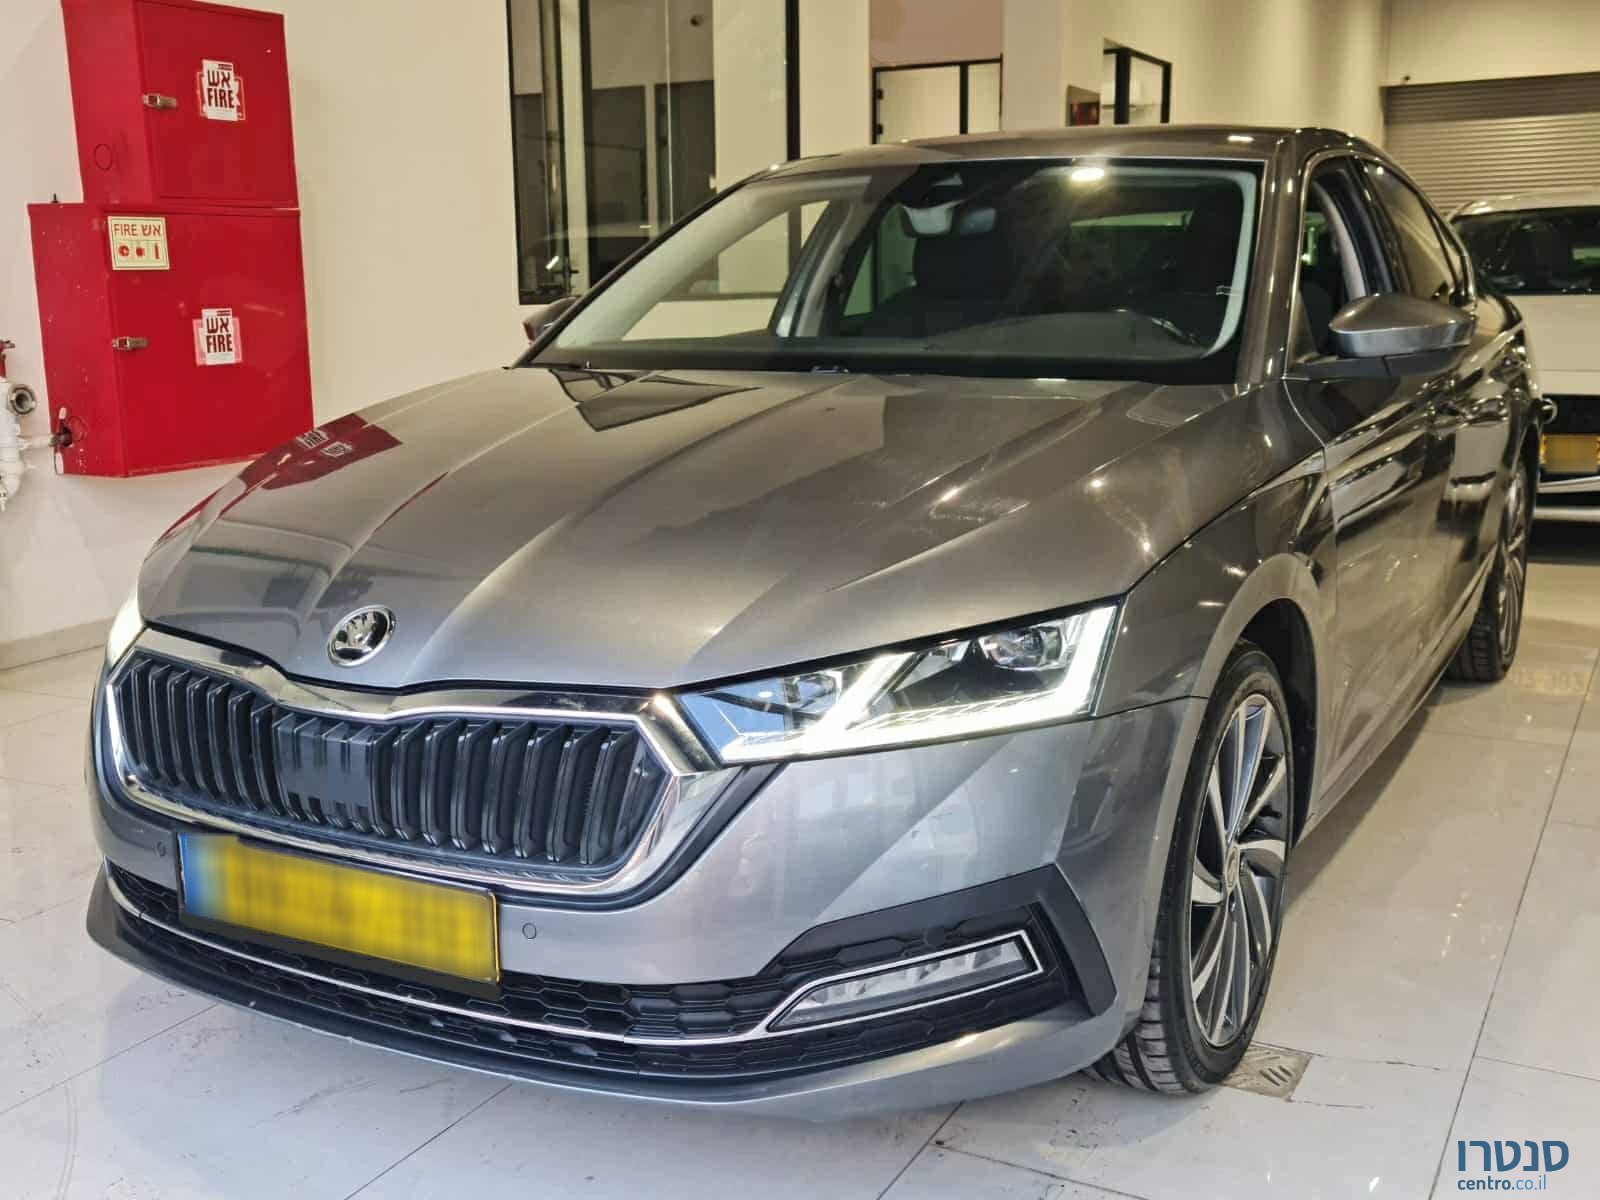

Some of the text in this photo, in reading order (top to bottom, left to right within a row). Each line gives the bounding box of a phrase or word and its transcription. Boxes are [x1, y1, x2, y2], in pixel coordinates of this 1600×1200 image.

[207, 70, 231, 88] אש
[207, 88, 235, 108] FIRE
[113, 224, 161, 237] FIRE אש
[206, 317, 229, 334] אש
[206, 334, 233, 353] FIRE
